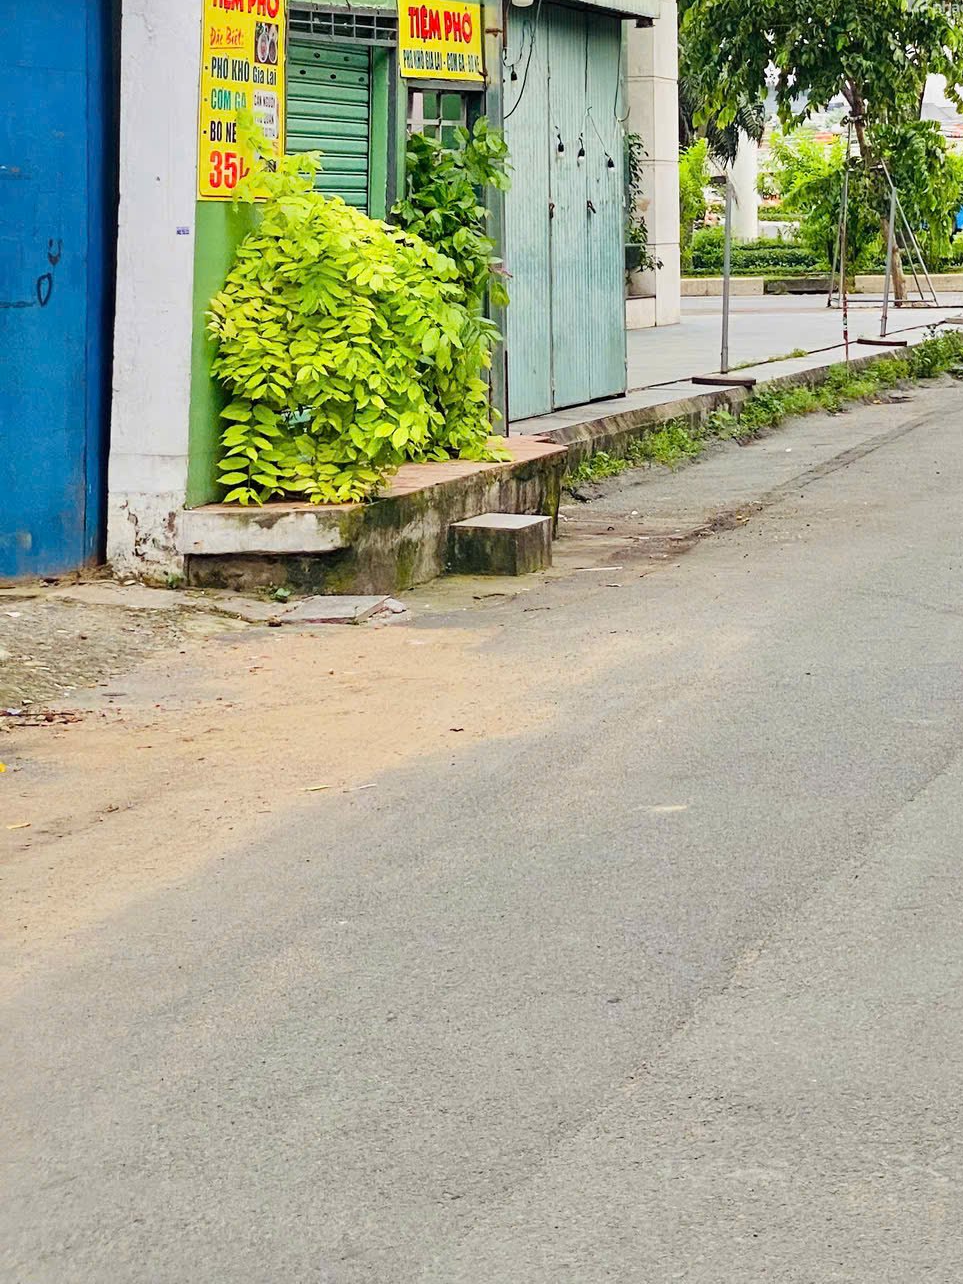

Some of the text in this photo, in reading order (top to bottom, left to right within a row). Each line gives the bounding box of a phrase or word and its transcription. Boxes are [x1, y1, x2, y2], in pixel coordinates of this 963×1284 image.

[408, 4, 473, 44] TIỆM PHỞ
[252, 66, 265, 85] Gia
